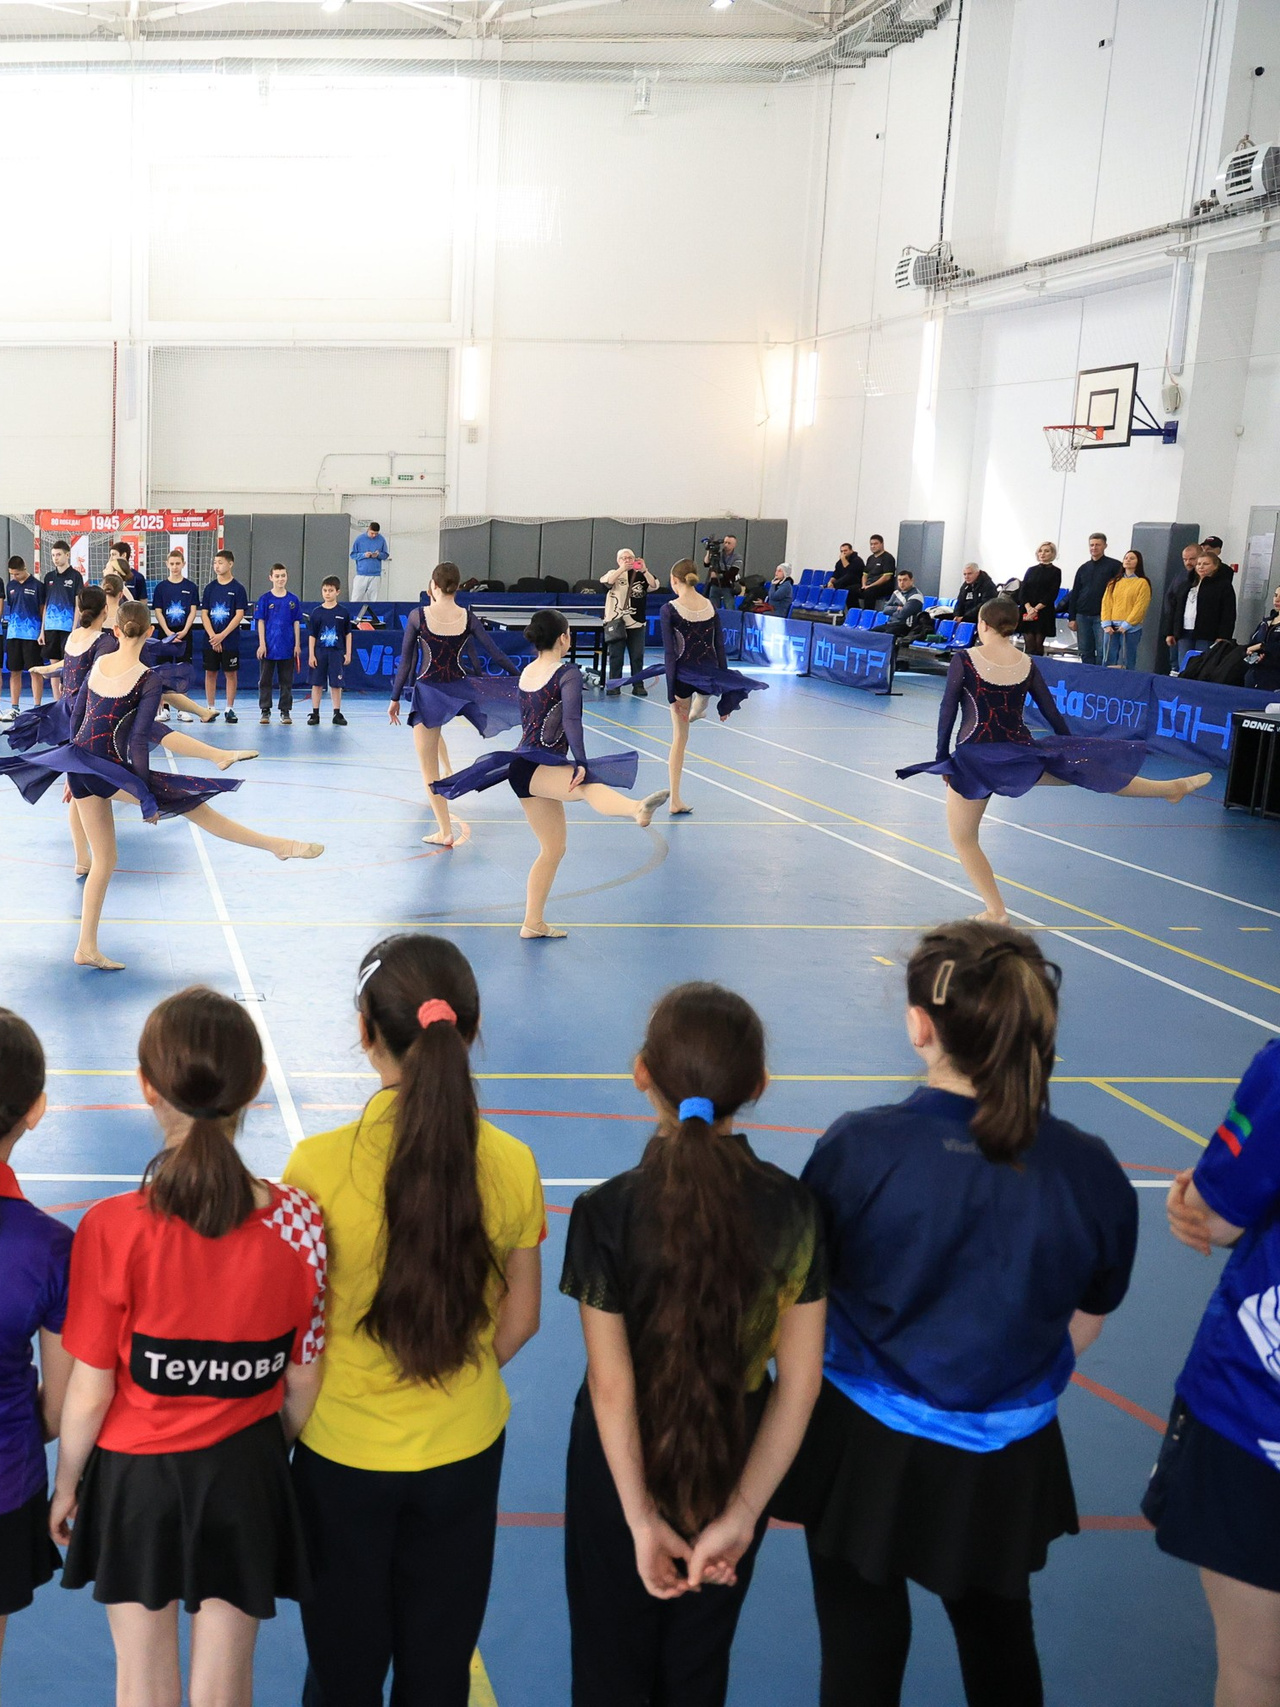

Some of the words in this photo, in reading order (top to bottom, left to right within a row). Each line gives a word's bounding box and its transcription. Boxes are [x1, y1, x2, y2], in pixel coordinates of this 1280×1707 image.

[90, 515, 120, 530] 1945
[132, 515, 164, 530] 2025
[1242, 719, 1275, 732] DONIC
[144, 1350, 286, 1386] Теунова
